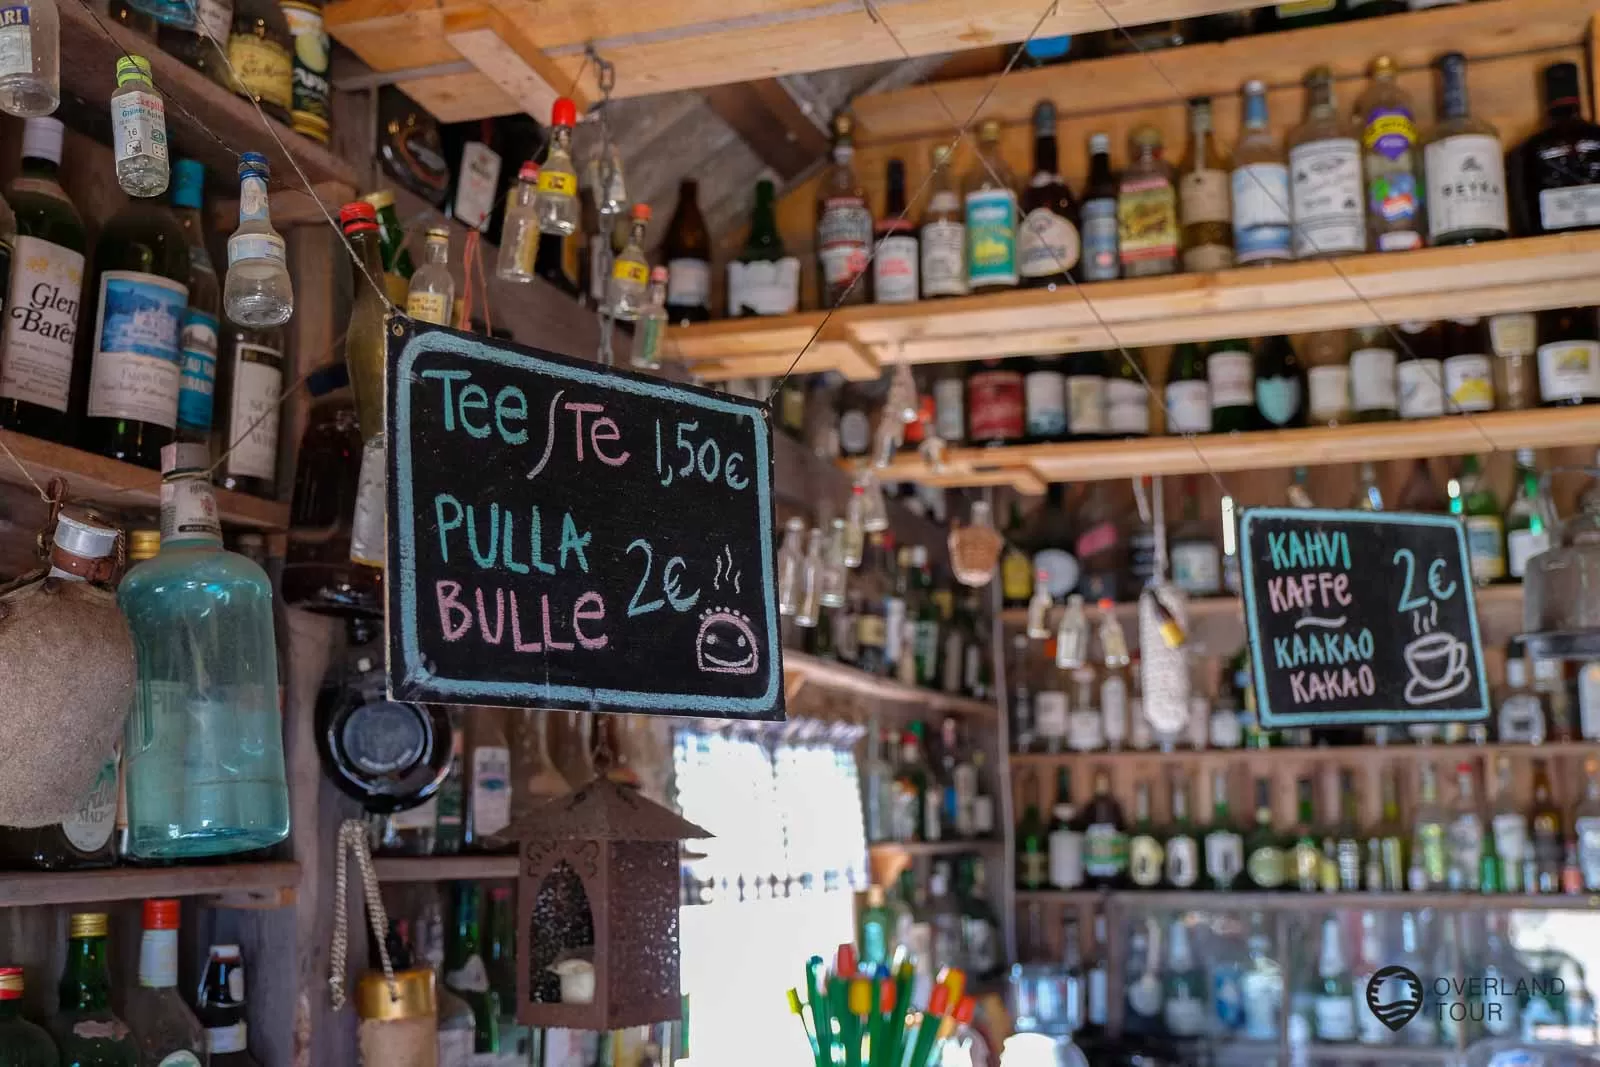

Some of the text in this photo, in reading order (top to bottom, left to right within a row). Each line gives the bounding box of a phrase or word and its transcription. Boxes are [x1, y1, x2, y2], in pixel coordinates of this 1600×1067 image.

[655, 419, 749, 490] 1,50€
[434, 493, 592, 575] PULLA
[1268, 531, 1352, 570] KAHVI
[626, 538, 701, 618] 2€
[1393, 548, 1457, 612] 2€
[1273, 628, 1375, 669] KAAKAO
[1290, 666, 1376, 704] KAKAO
